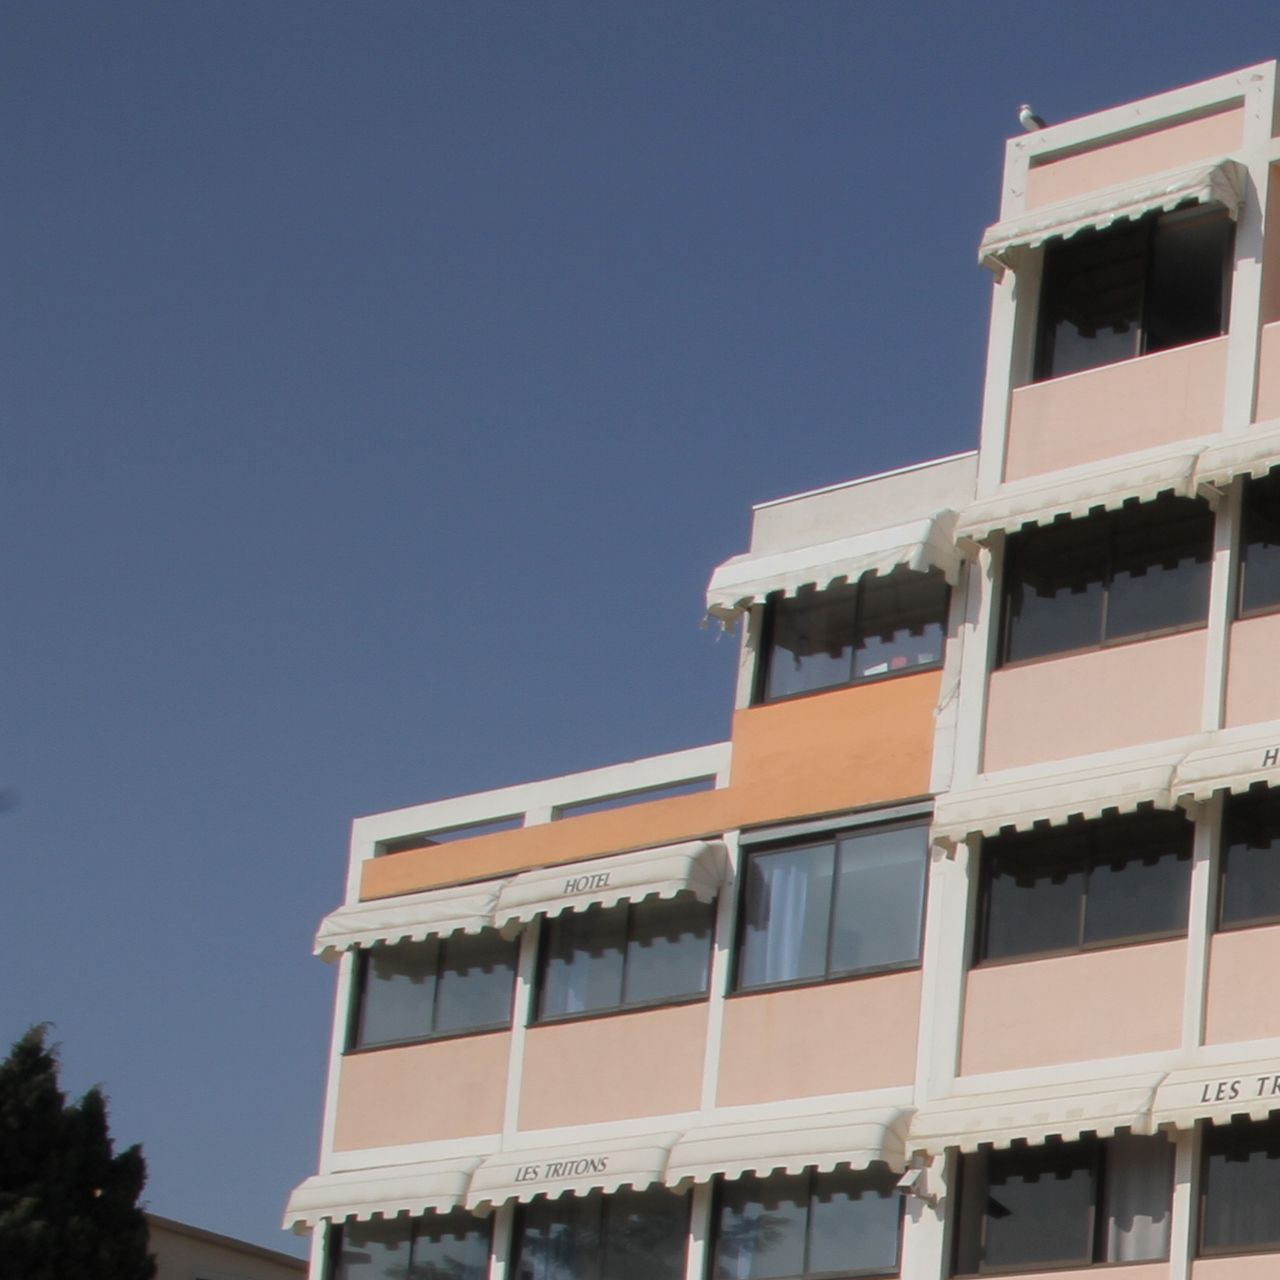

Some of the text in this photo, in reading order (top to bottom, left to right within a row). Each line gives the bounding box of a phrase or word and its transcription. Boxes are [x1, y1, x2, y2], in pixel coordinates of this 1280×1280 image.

[563, 871, 612, 896] HOTEL
[1200, 1080, 1241, 1103] LES
[514, 1156, 609, 1184] LES TRITONS
